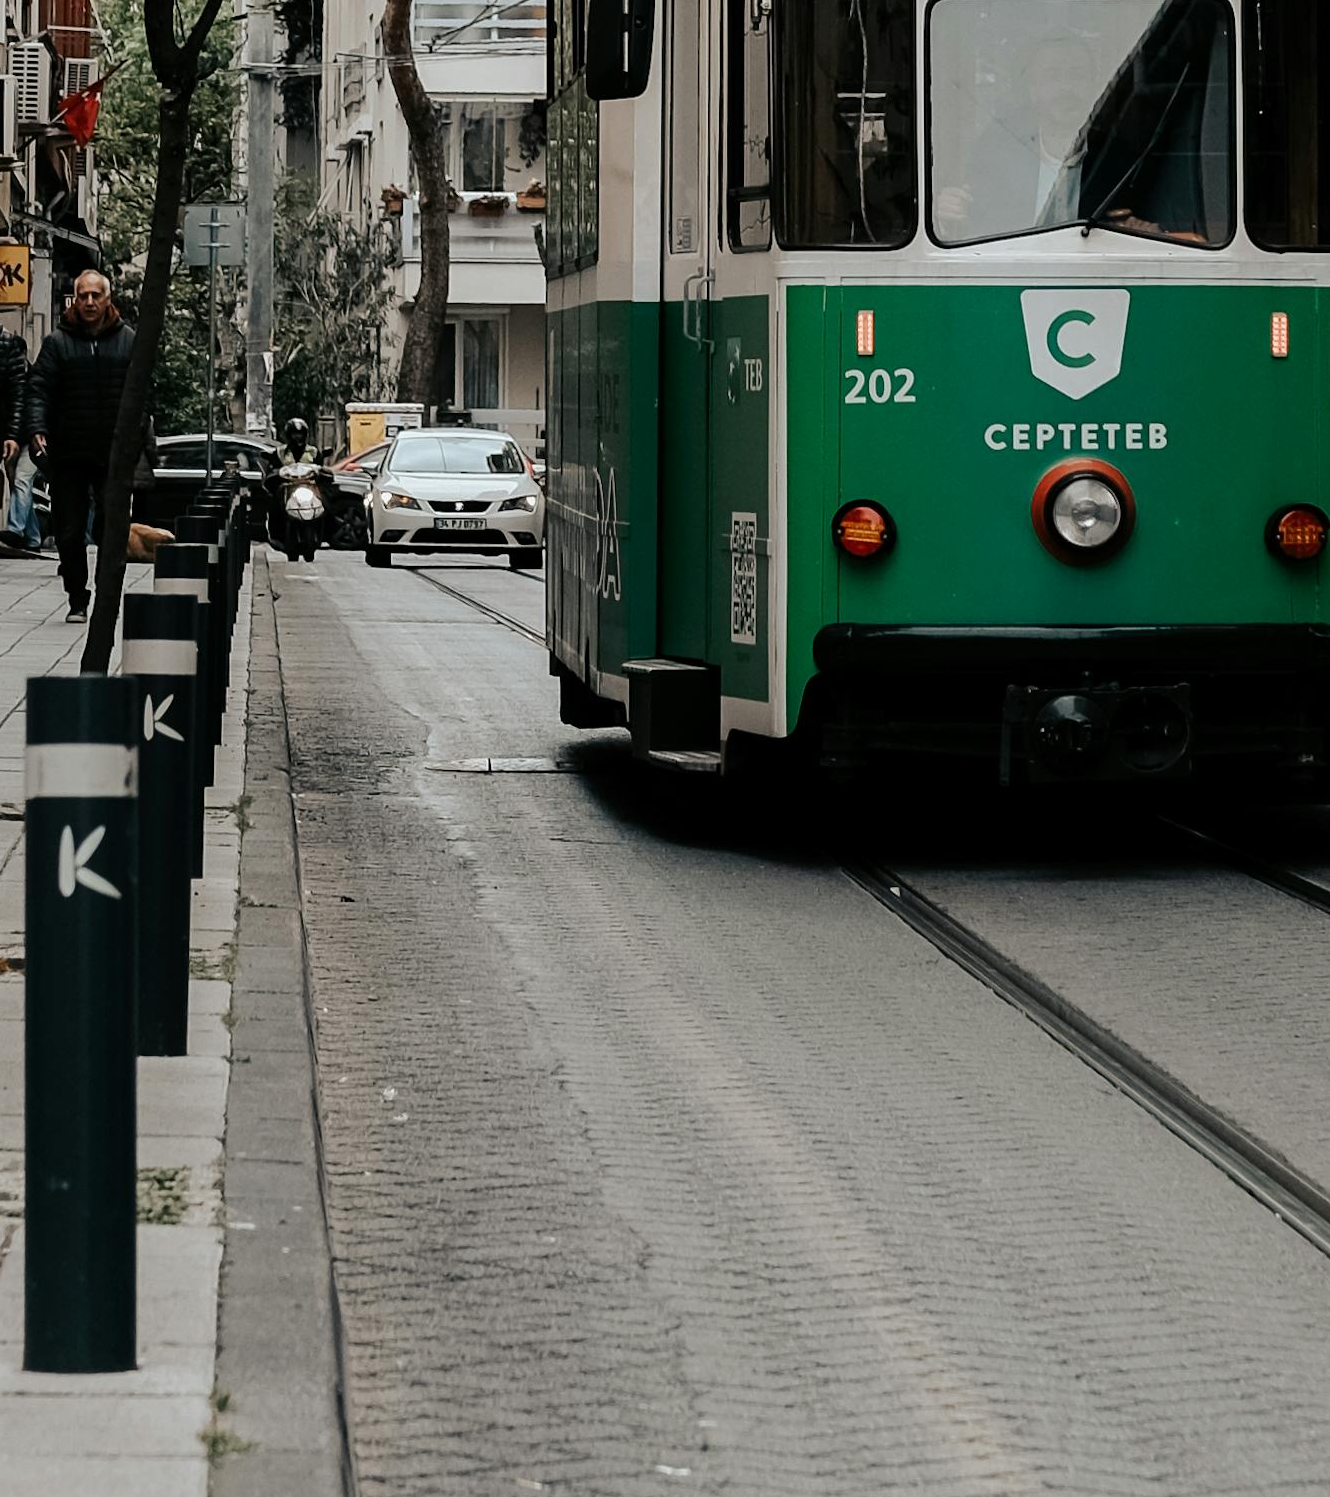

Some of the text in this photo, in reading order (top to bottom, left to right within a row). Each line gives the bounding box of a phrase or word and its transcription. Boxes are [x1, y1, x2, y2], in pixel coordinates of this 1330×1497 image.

[1046, 309, 1096, 369] C
[744, 358, 763, 392] TEB
[844, 367, 917, 405] 202
[984, 422, 1168, 451] CEPTETEB
[143, 693, 185, 742] K
[57, 824, 122, 900] K
